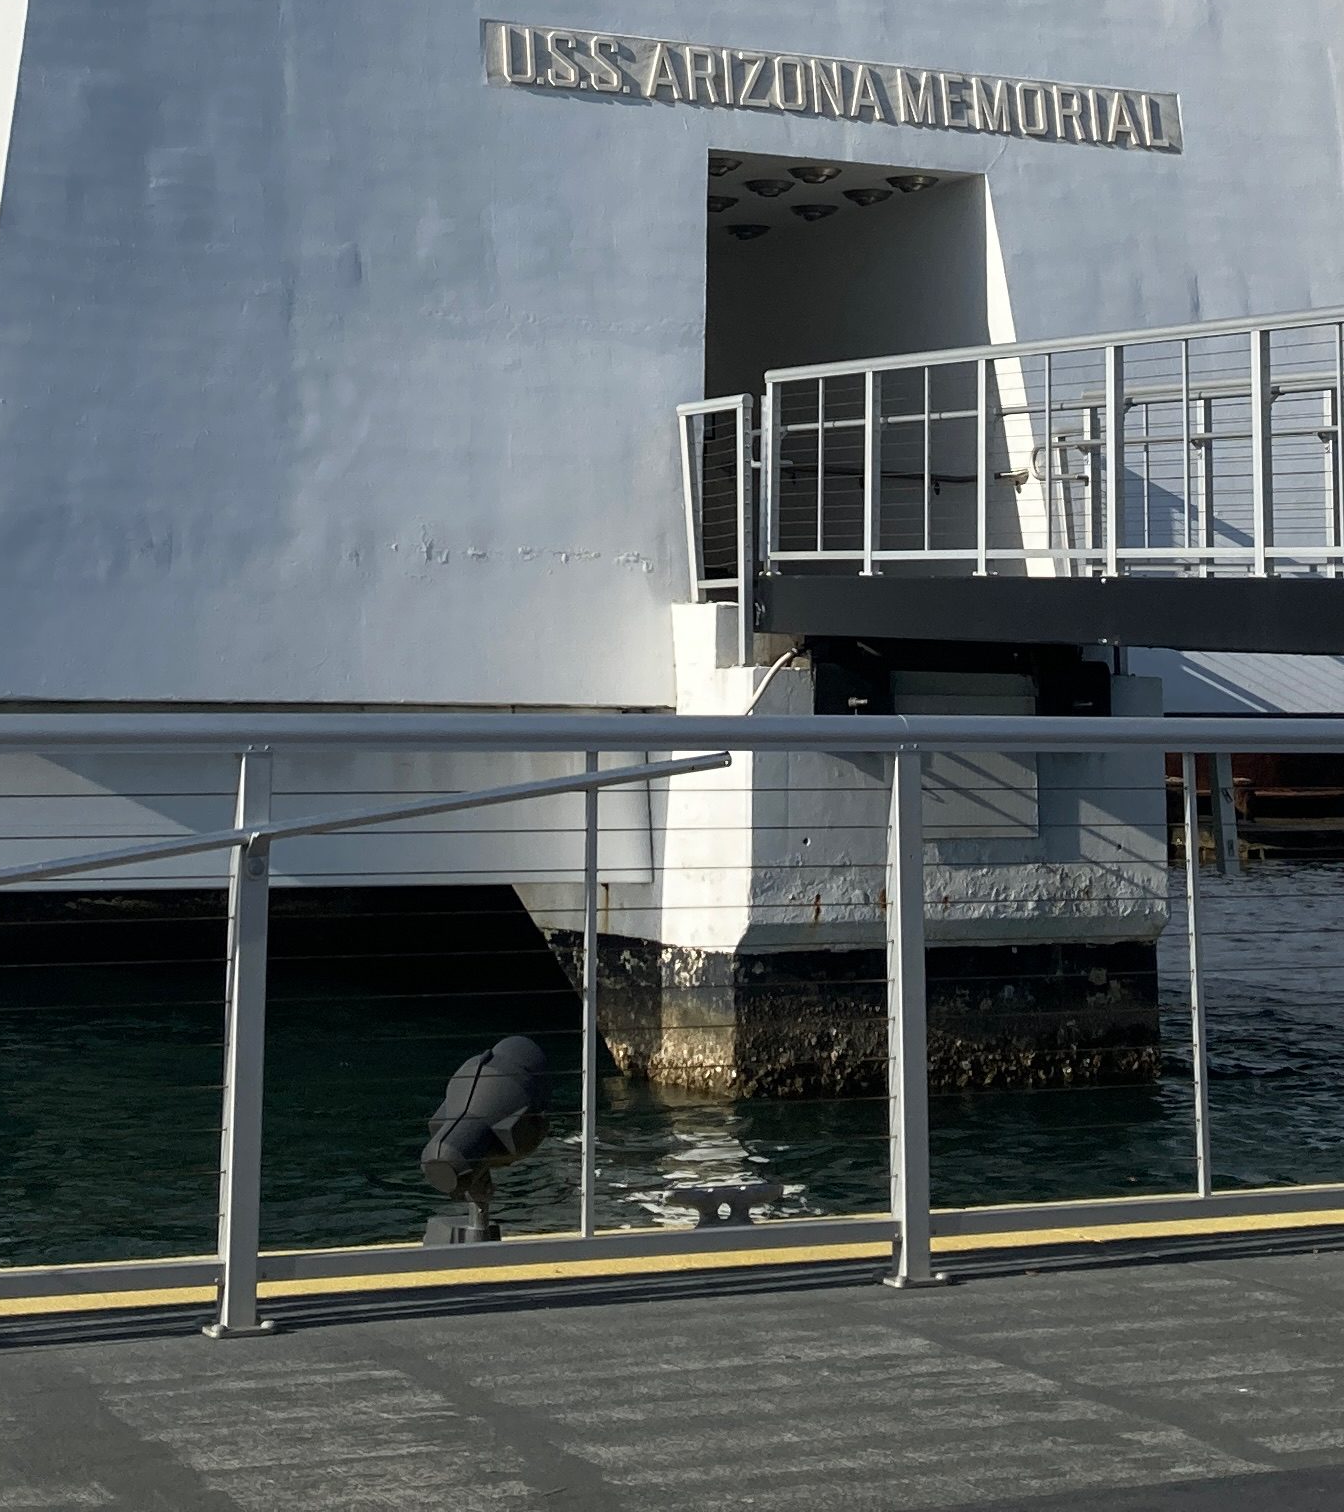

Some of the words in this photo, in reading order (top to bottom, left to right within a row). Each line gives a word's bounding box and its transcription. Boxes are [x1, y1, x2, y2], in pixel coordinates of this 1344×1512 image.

[499, 24, 631, 93] U.S.S.
[646, 41, 884, 121] ARIZONA
[896, 69, 1170, 148] MEMORIAL
